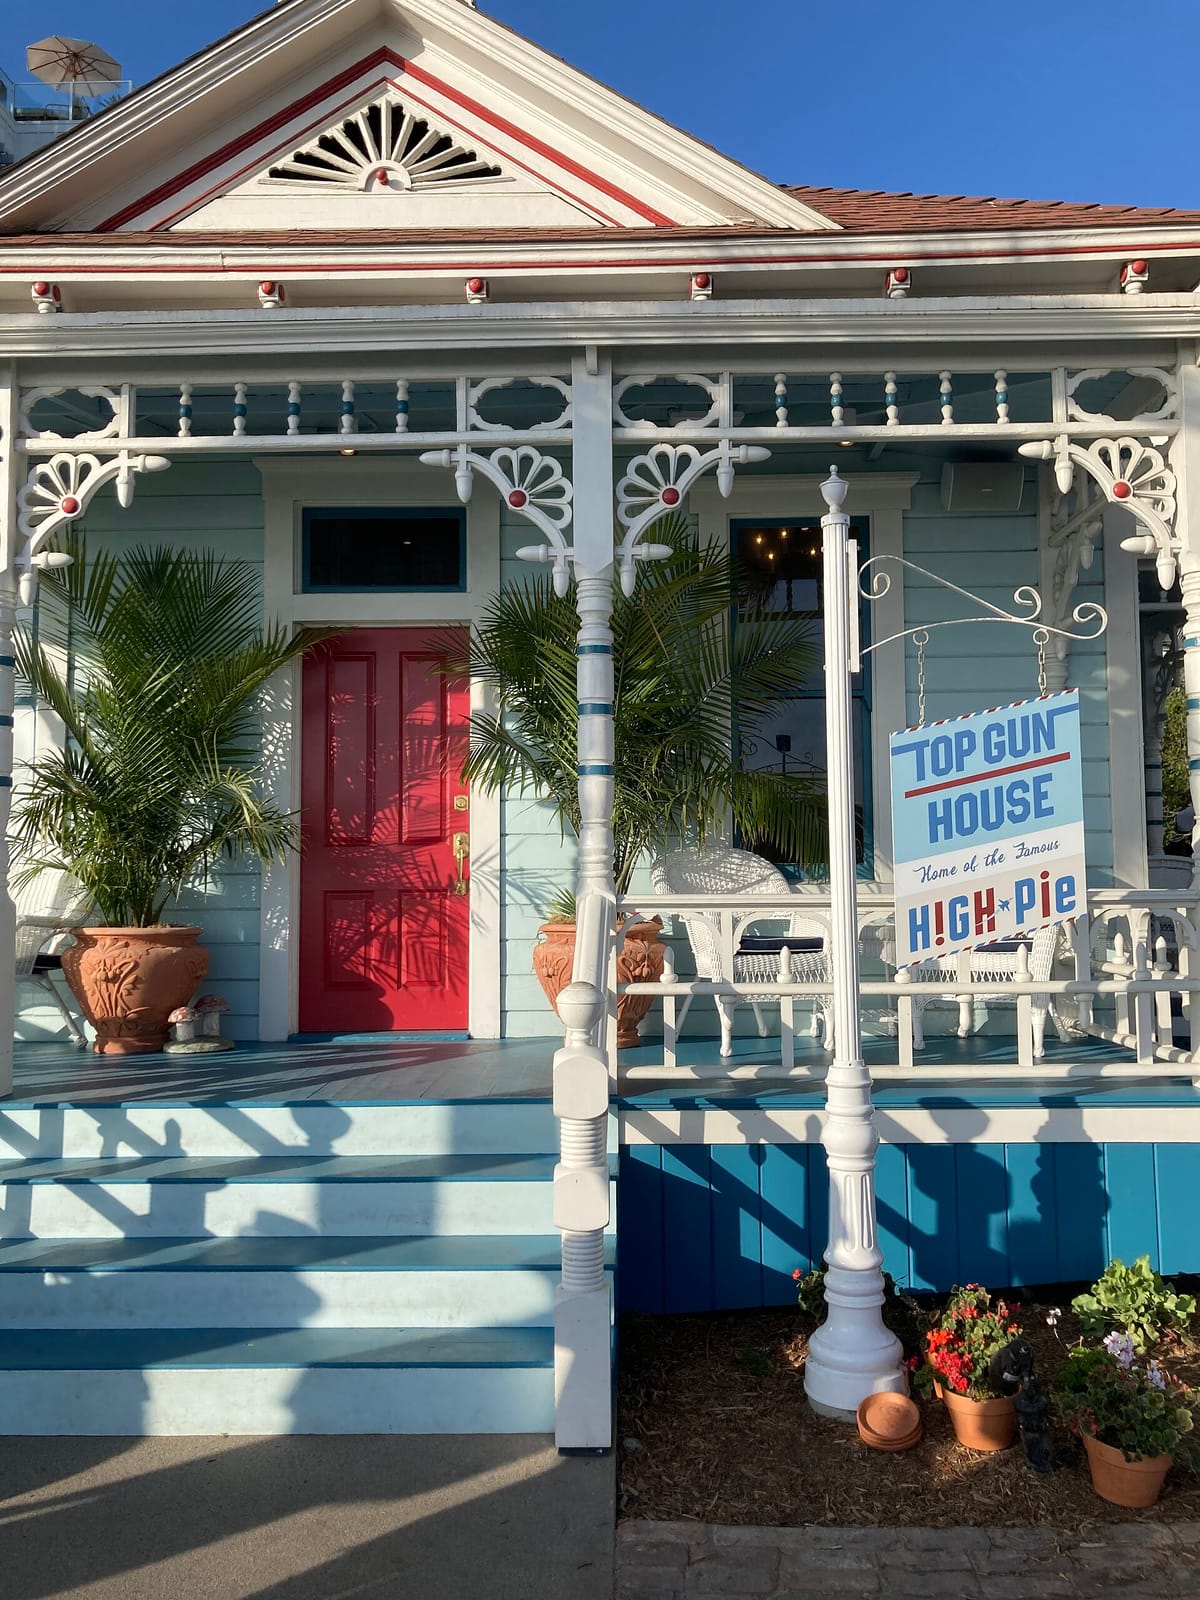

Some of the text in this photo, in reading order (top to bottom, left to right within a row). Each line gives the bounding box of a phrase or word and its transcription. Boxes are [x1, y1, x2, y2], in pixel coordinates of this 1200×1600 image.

[891, 702, 1080, 782] TOP GUN
[927, 772, 1055, 844] HOUSE
[911, 839, 1060, 883] Home of the Famous
[1014, 870, 1076, 926] Pie
